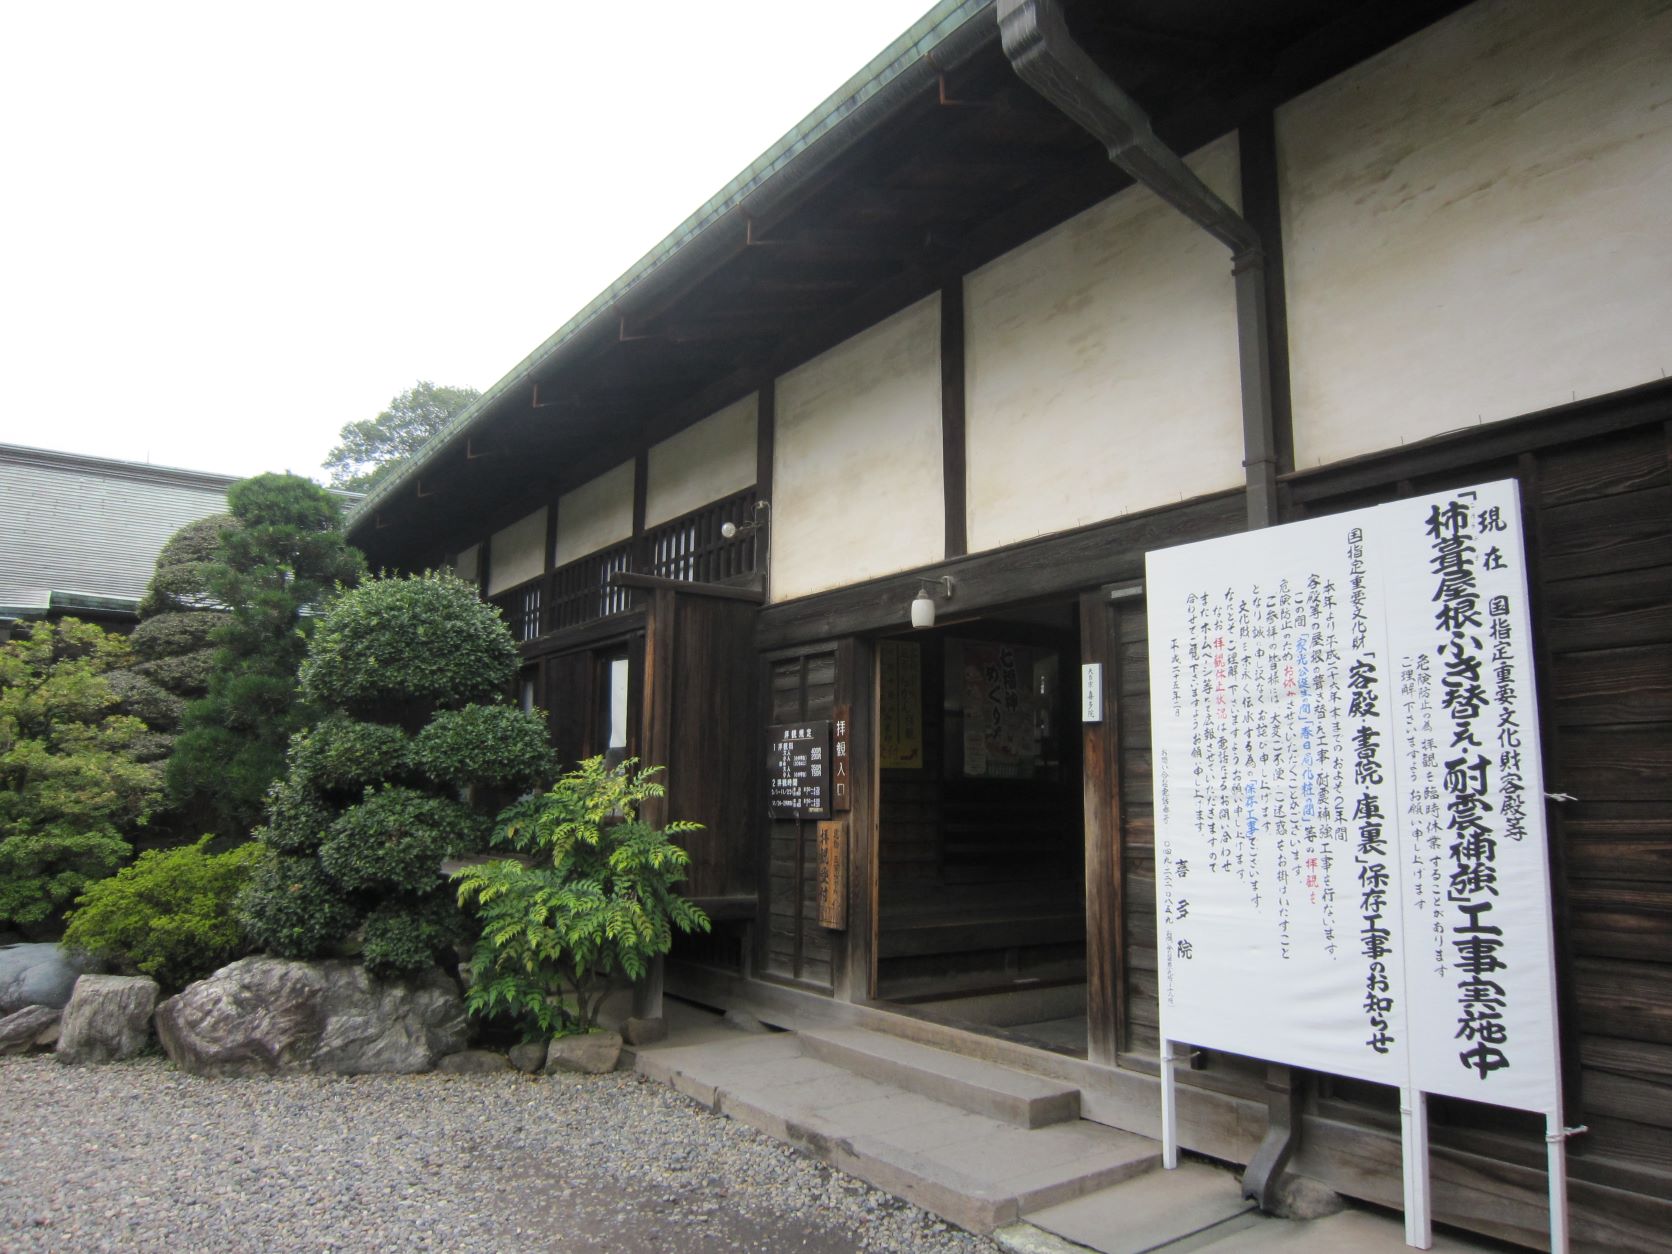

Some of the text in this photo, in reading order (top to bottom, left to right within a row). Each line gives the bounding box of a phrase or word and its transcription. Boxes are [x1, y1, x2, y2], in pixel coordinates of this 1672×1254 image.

[1477, 505, 1508, 573] 現在
[836, 720, 847, 796] 拝観入口
[1176, 860, 1193, 960] 喜多院
